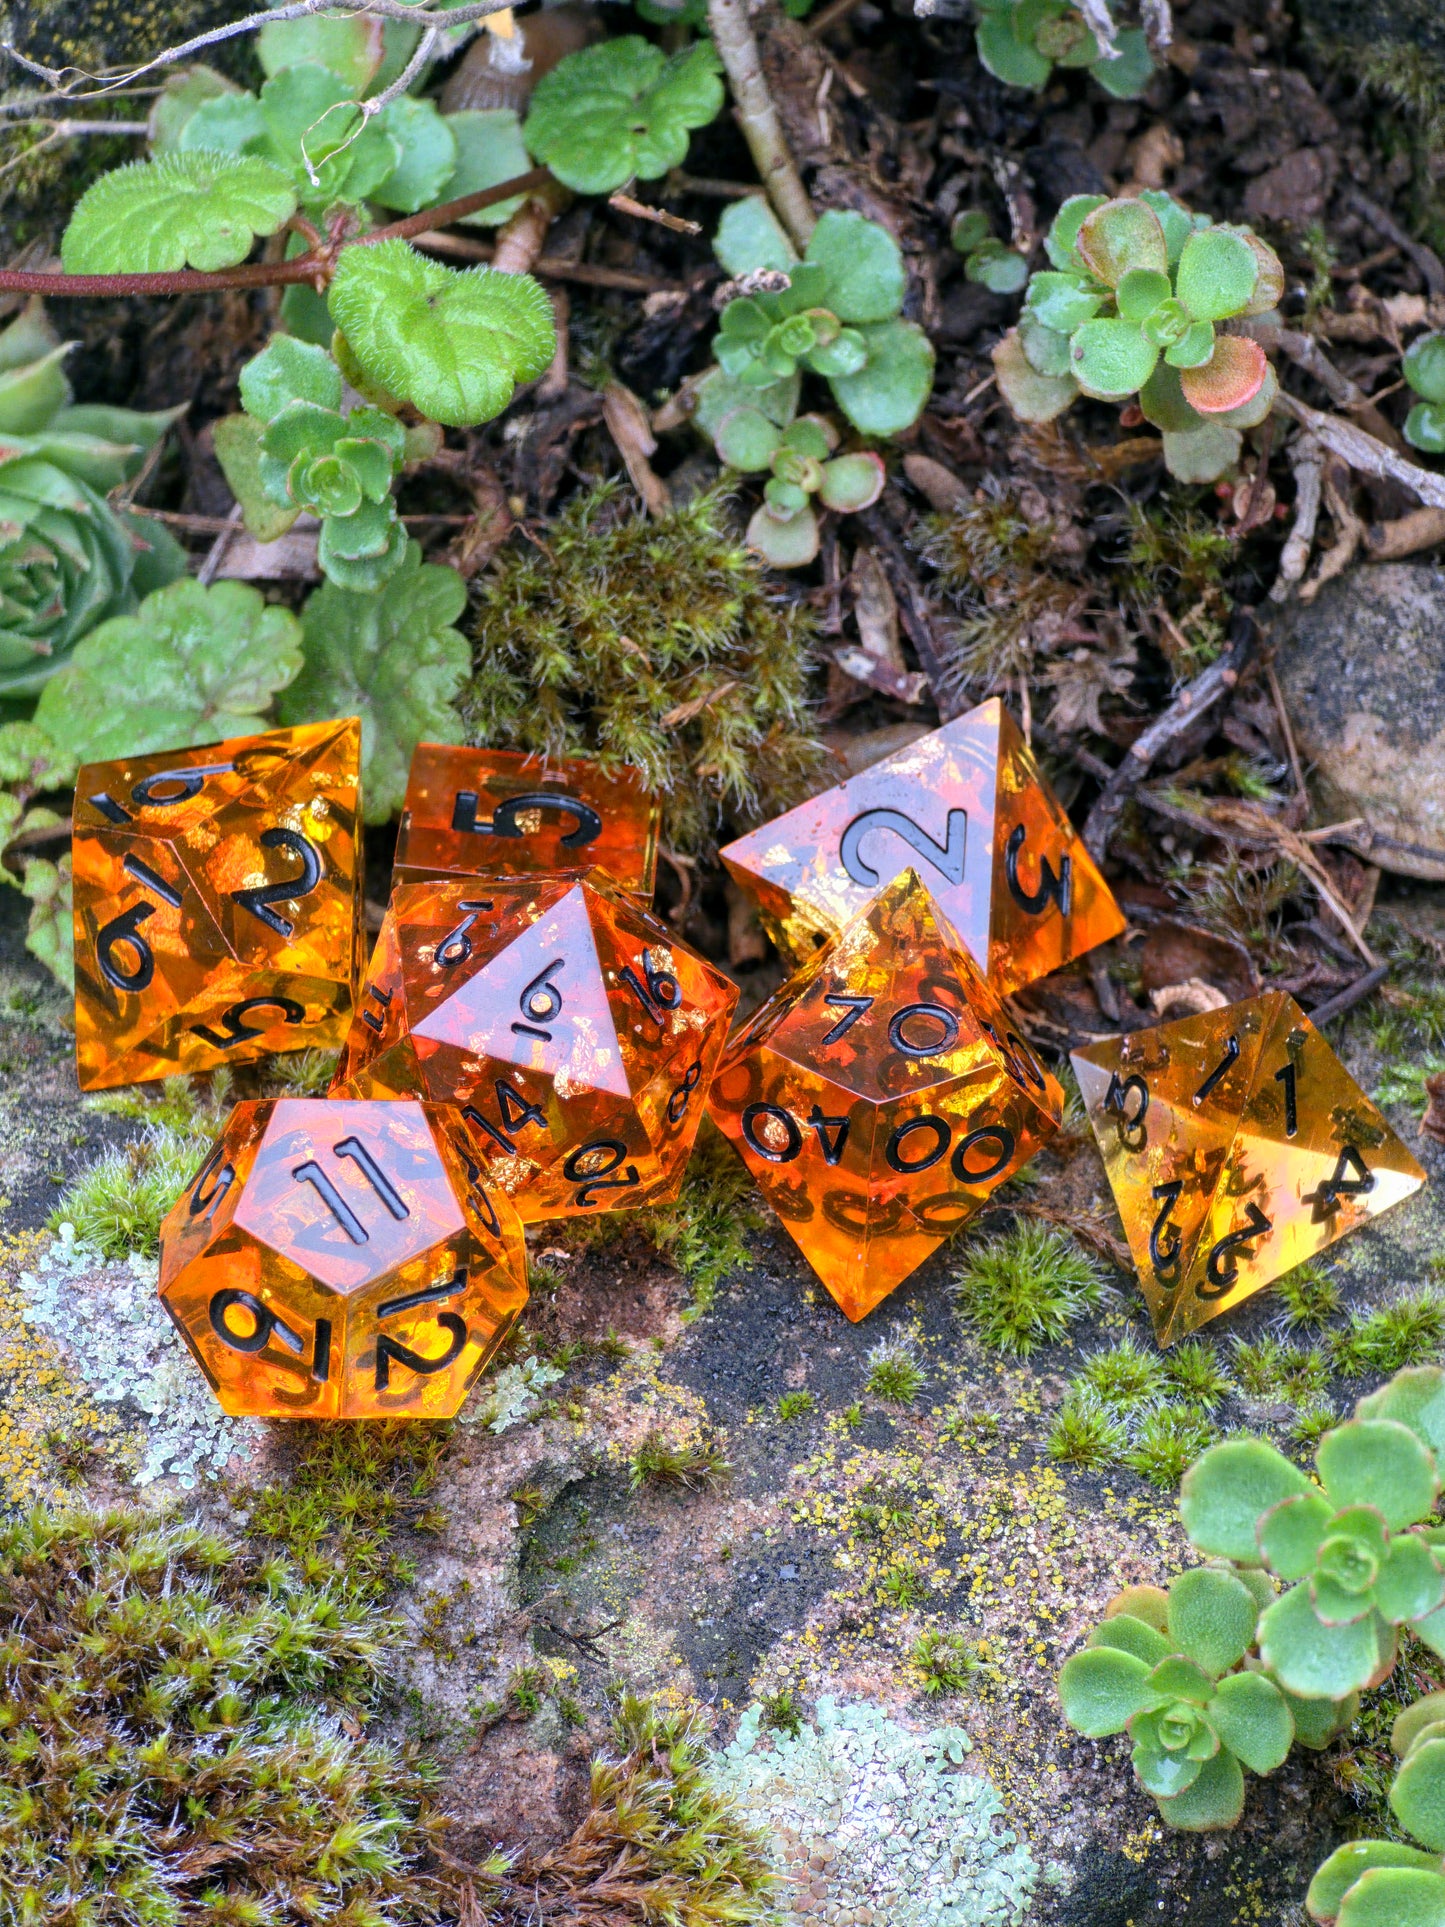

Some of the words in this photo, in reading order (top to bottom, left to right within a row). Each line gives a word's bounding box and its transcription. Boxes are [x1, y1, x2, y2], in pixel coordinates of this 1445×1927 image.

[452, 791, 602, 848] 5
[840, 808, 967, 888] 2
[231, 827, 323, 937] 2
[1005, 824, 1071, 917] 3
[189, 996, 306, 1050] 5
[617, 947, 682, 1026] 16
[822, 993, 960, 1057] 70
[461, 1079, 549, 1155] 14
[667, 1060, 701, 1123] 8
[1275, 1063, 1298, 1139] 1
[741, 1102, 851, 1166] 40
[886, 1114, 1016, 1184] 00
[292, 1135, 411, 1246] 11
[563, 1138, 641, 1208] 20
[1317, 1145, 1376, 1204] 4
[1151, 1180, 1185, 1271] 2
[1206, 1202, 1274, 1287] 2
[376, 1268, 469, 1392] 12
